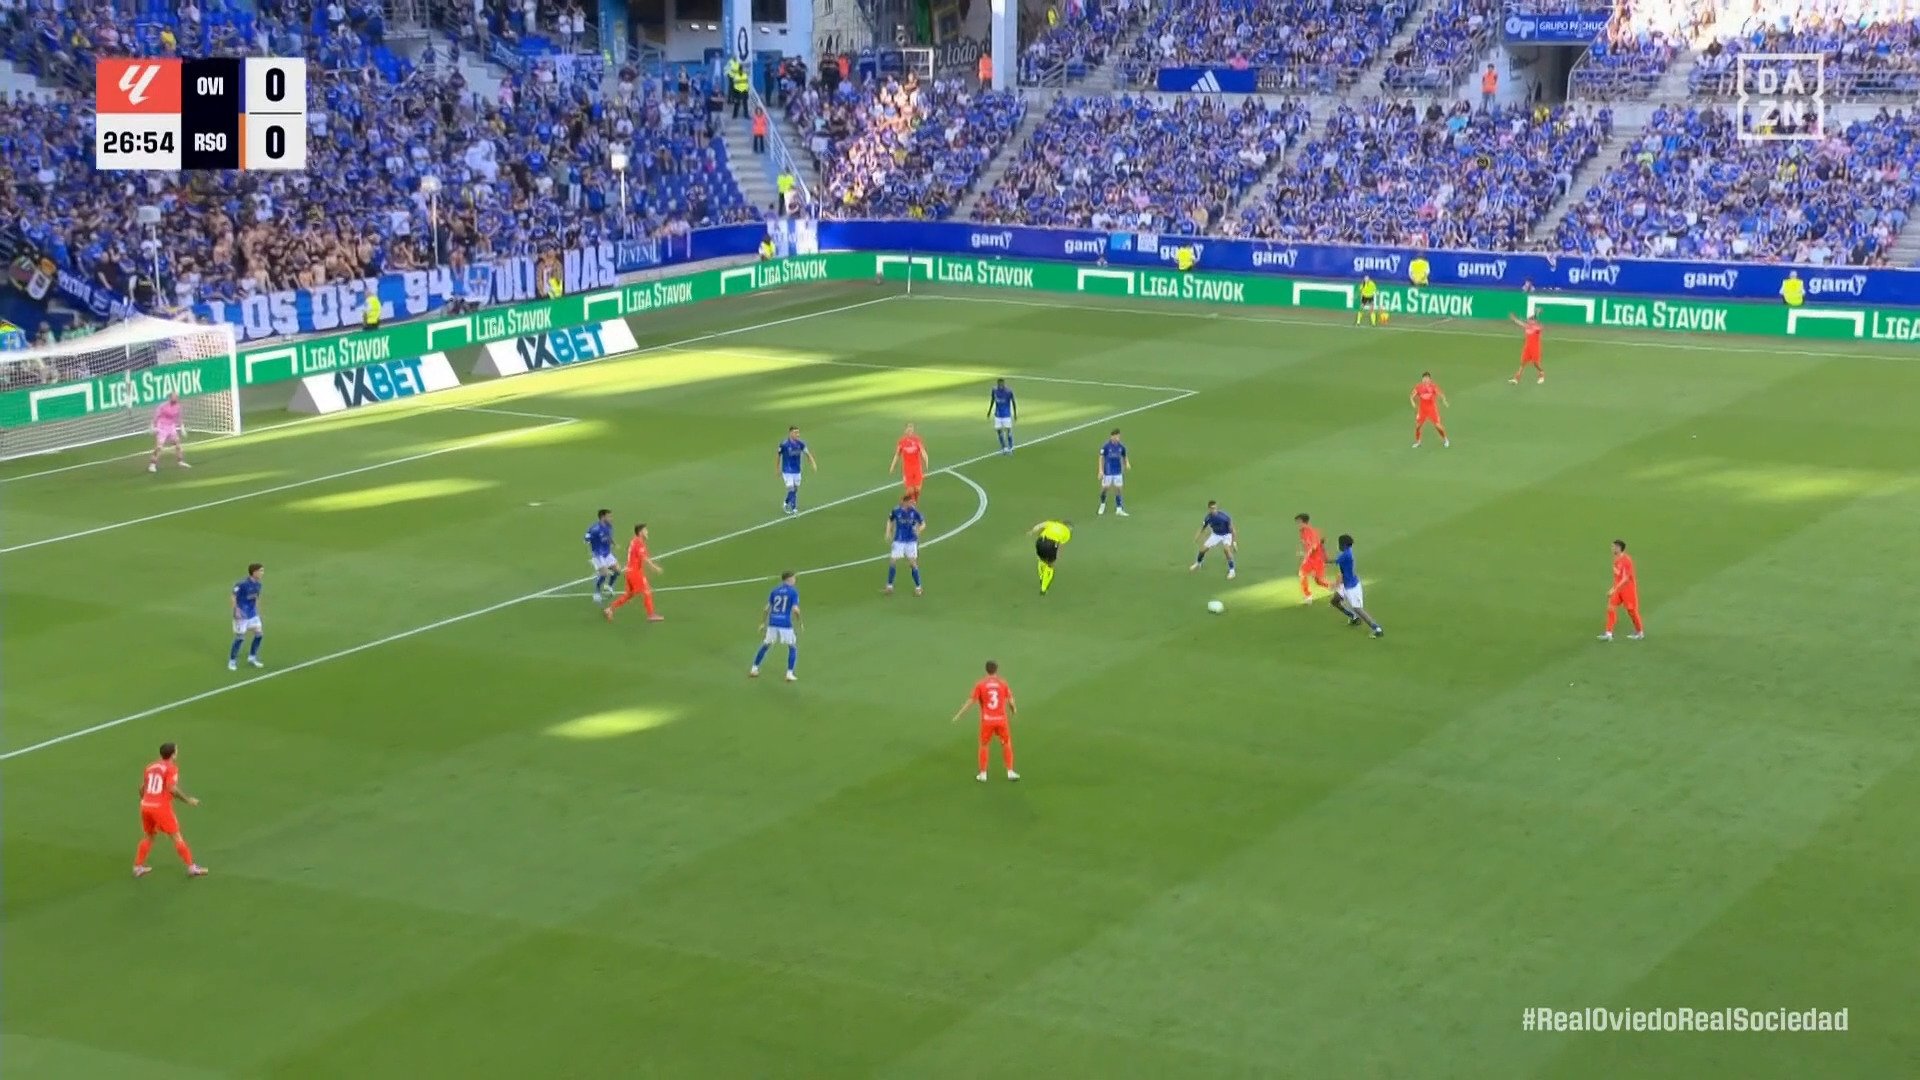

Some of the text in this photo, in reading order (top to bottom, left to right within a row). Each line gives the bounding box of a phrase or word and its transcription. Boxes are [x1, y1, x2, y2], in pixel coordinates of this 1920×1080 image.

[1540, 21, 1568, 31] GRUPO
[1160, 243, 1204, 263] gy
[758, 258, 828, 288] LIGA STAVOK
[938, 257, 1034, 288] LIGA STAVOK
[1140, 272, 1245, 302] LIGA STAVOK
[209, 291, 299, 342] LOS
[404, 265, 453, 315] 94
[626, 281, 693, 313] LIGA STAVOK
[1362, 287, 1474, 317] IGA STAVOK
[475, 307, 552, 341] LIGA STAVOK
[1601, 298, 1728, 331] LIGA STAVOK
[302, 335, 391, 373] LIGA STAVOK
[516, 324, 606, 371] 1XBET
[99, 368, 203, 410] LIGA STAVOK
[334, 356, 428, 408] 1XBET
[773, 594, 789, 613] 21
[987, 688, 999, 710] 3
[147, 772, 164, 795] 10
